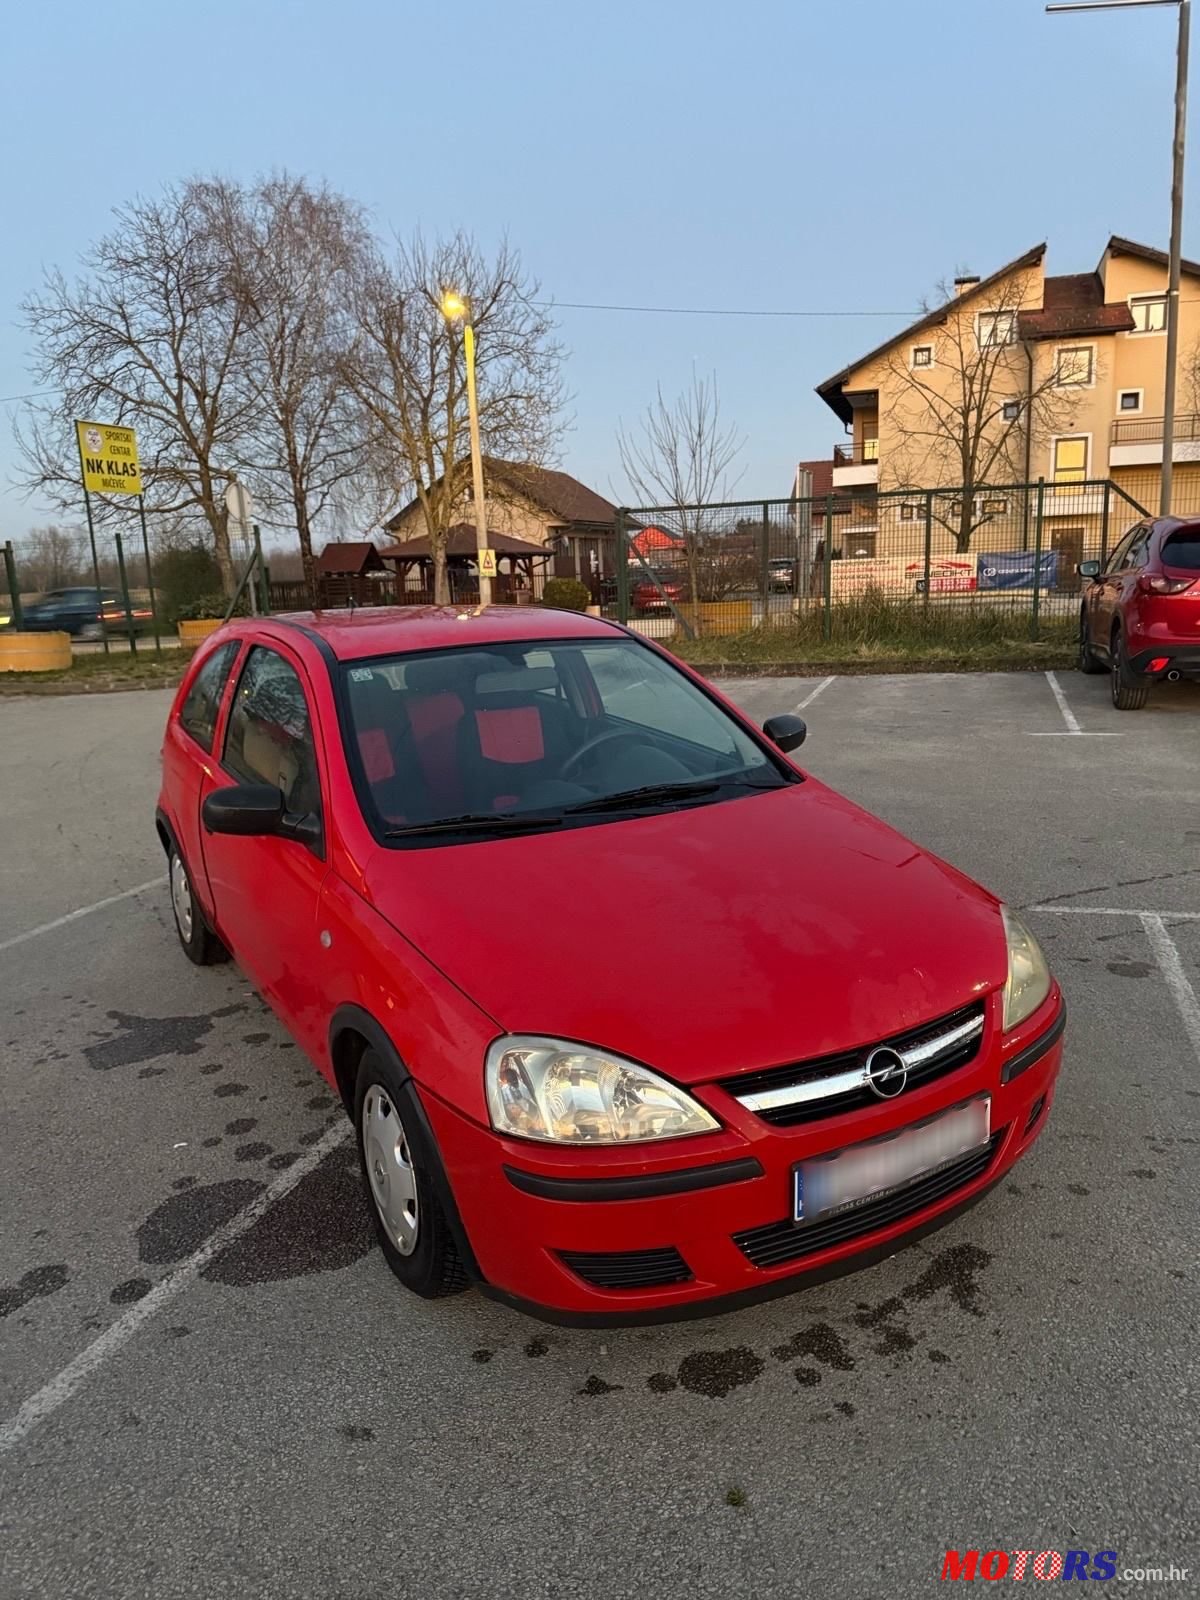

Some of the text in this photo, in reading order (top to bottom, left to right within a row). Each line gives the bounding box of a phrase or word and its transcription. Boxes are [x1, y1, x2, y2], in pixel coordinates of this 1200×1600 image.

[105, 430, 132, 443] SPORTSKI
[109, 445, 131, 456] CENTAR
[86, 458, 137, 477] NK KLAS
